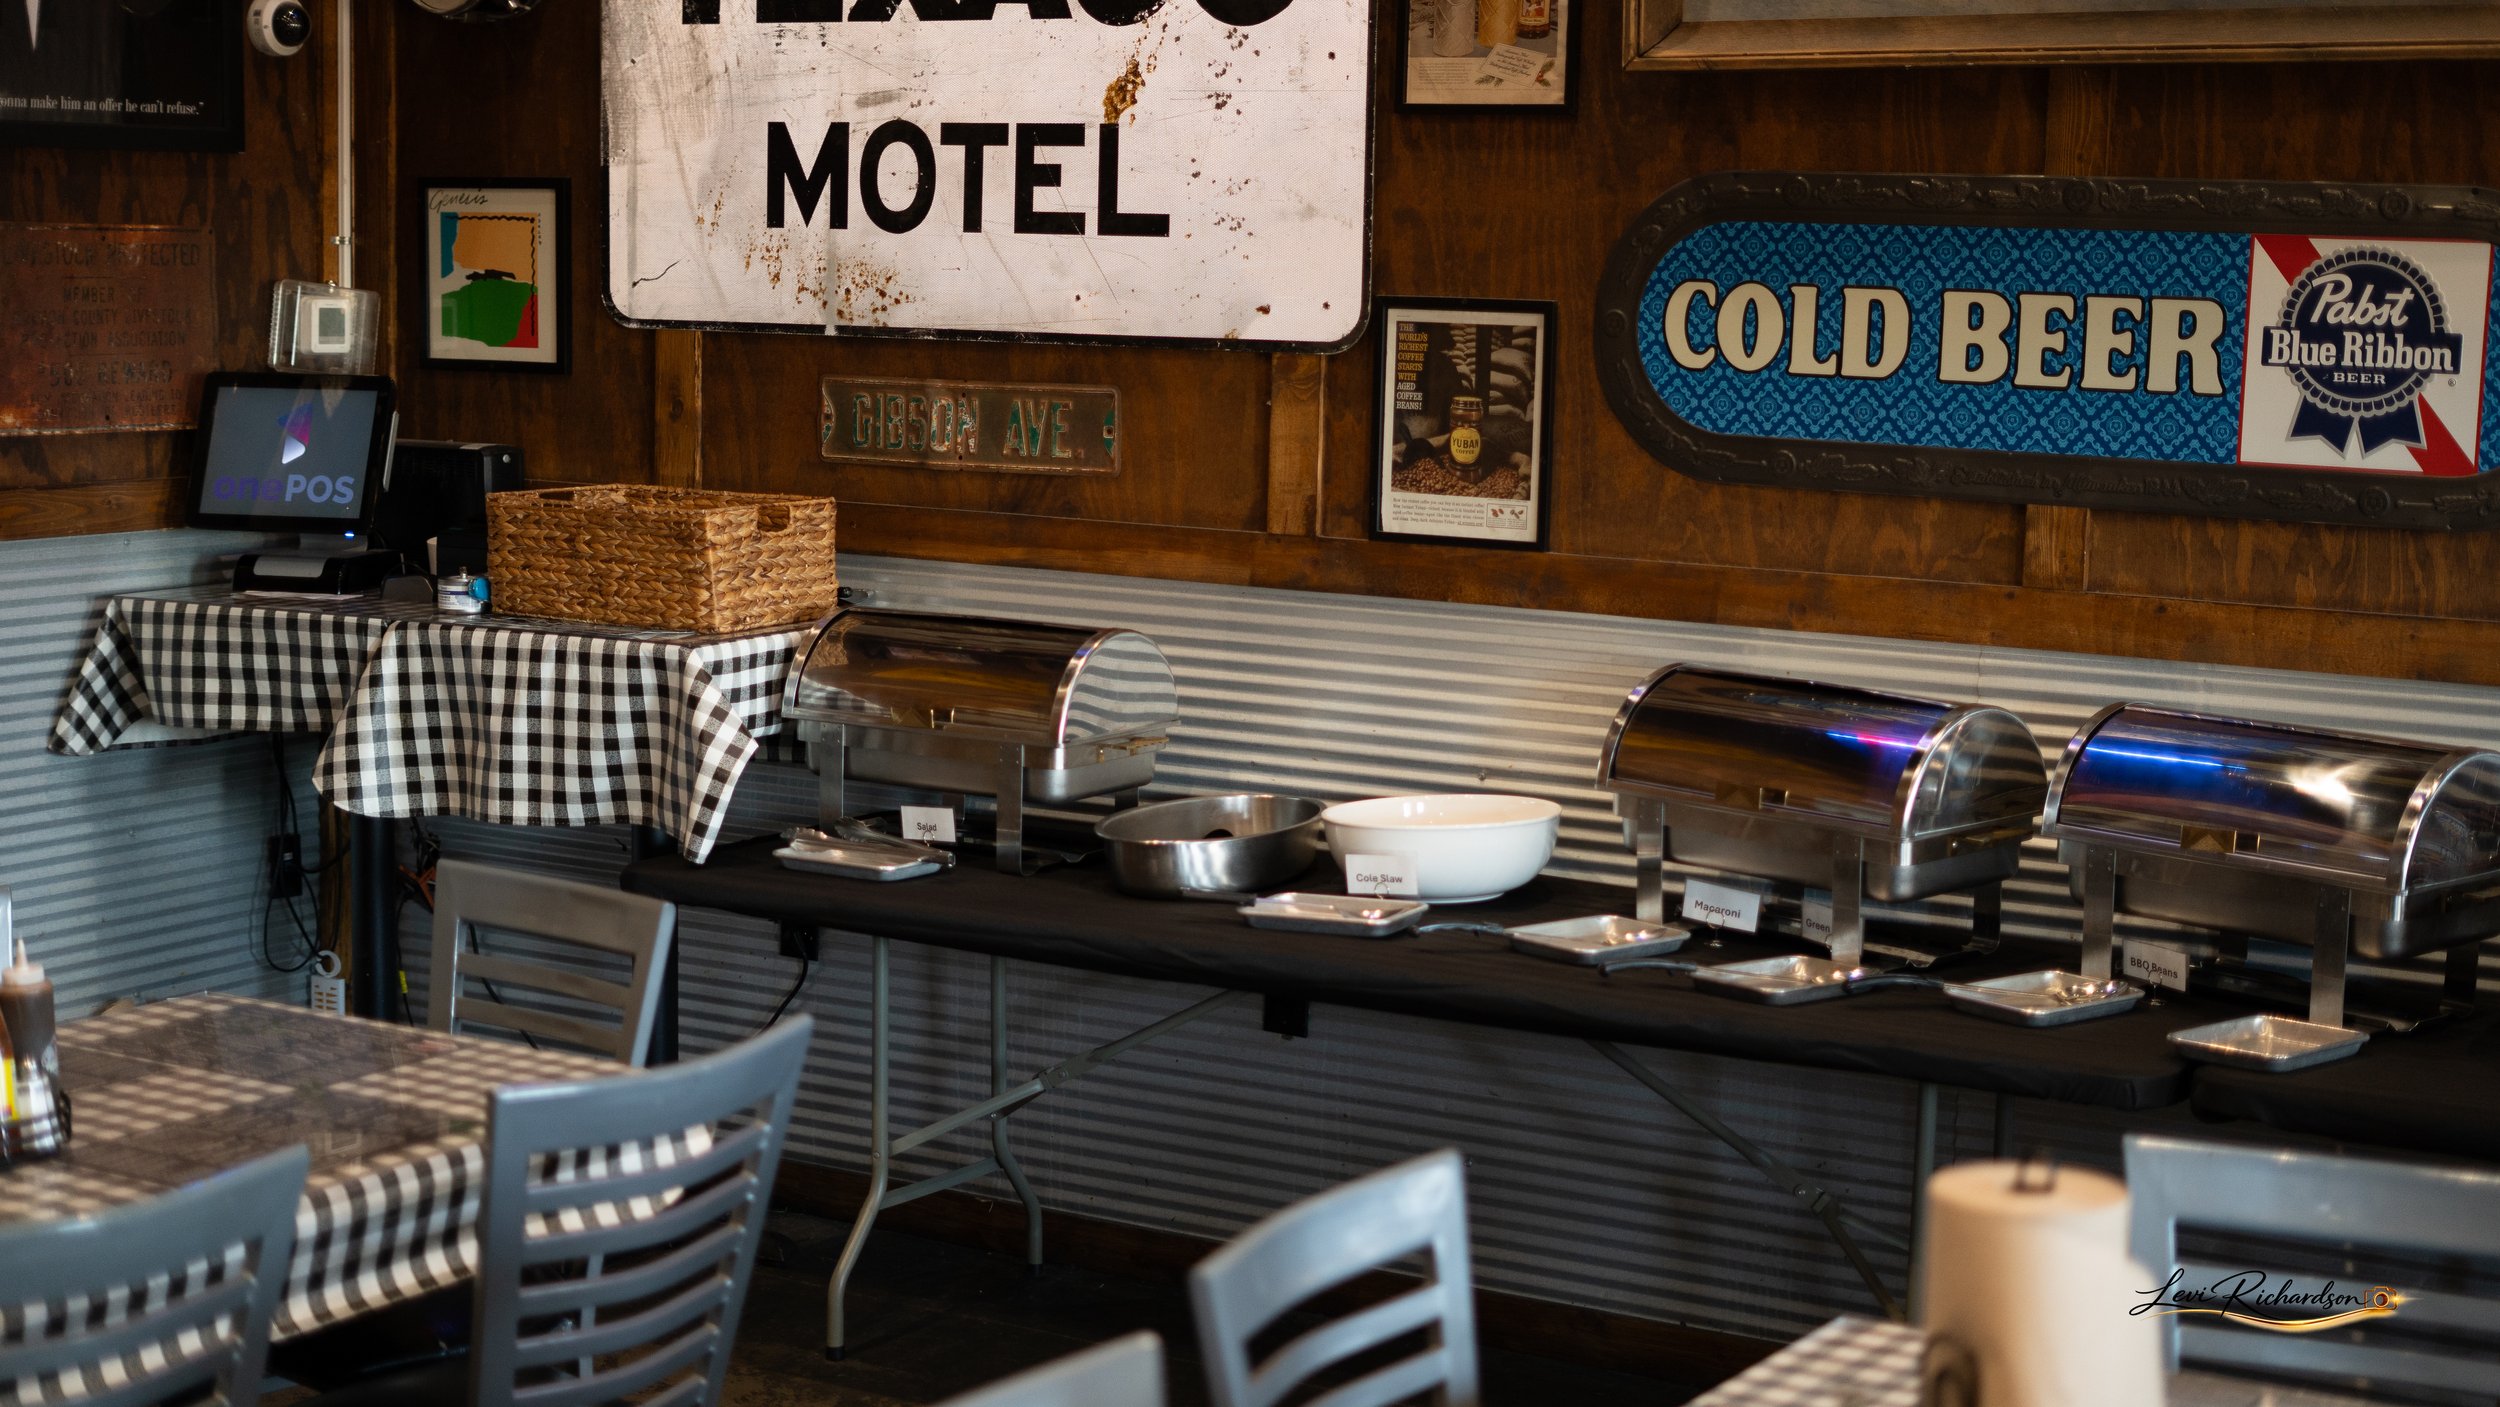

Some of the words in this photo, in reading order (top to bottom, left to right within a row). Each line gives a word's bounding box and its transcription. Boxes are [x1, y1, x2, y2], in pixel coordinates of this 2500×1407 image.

[0, 97, 27, 108] onna
[30, 95, 58, 109] make
[61, 96, 81, 110] him
[83, 99, 97, 111] an
[99, 97, 123, 112] offer
[126, 98, 138, 112] he
[140, 99, 164, 113] can't
[767, 119, 1170, 237] MOTEL
[429, 188, 489, 213] Genesis
[63, 286, 116, 304] MEMBER
[2311, 273, 2415, 327] Pabst
[72, 308, 119, 326] COUNTY
[1400, 323, 1414, 332] THE
[1399, 332, 1428, 342] WORLD'S
[1664, 279, 1912, 379] COLD
[1936, 289, 2227, 395] BEER
[1399, 343, 1429, 352] RICHEST
[2268, 329, 2337, 368] Blue
[2341, 331, 2454, 371] Ribbon
[1397, 352, 1424, 361] COFFEE
[1397, 362, 1423, 371] STARTS
[1398, 373, 1416, 381] WITH
[2333, 372, 2387, 385] BEER
[1397, 382, 1416, 391] AGED
[1396, 391, 1423, 401] COFFEE
[1396, 401, 1422, 410] BEANS!
[853, 392, 979, 454] GIBSON
[1452, 436, 1479, 449] YUBAN
[213, 473, 356, 505] onePOS
[917, 822, 937, 832] Salad
[1356, 873, 1378, 882] Cole
[1380, 873, 1403, 883] Slaw
[1694, 900, 1741, 919] Macaroni
[1805, 918, 1831, 933] Green
[2130, 957, 2150, 972] BBQ
[2151, 963, 2178, 979] Beans
